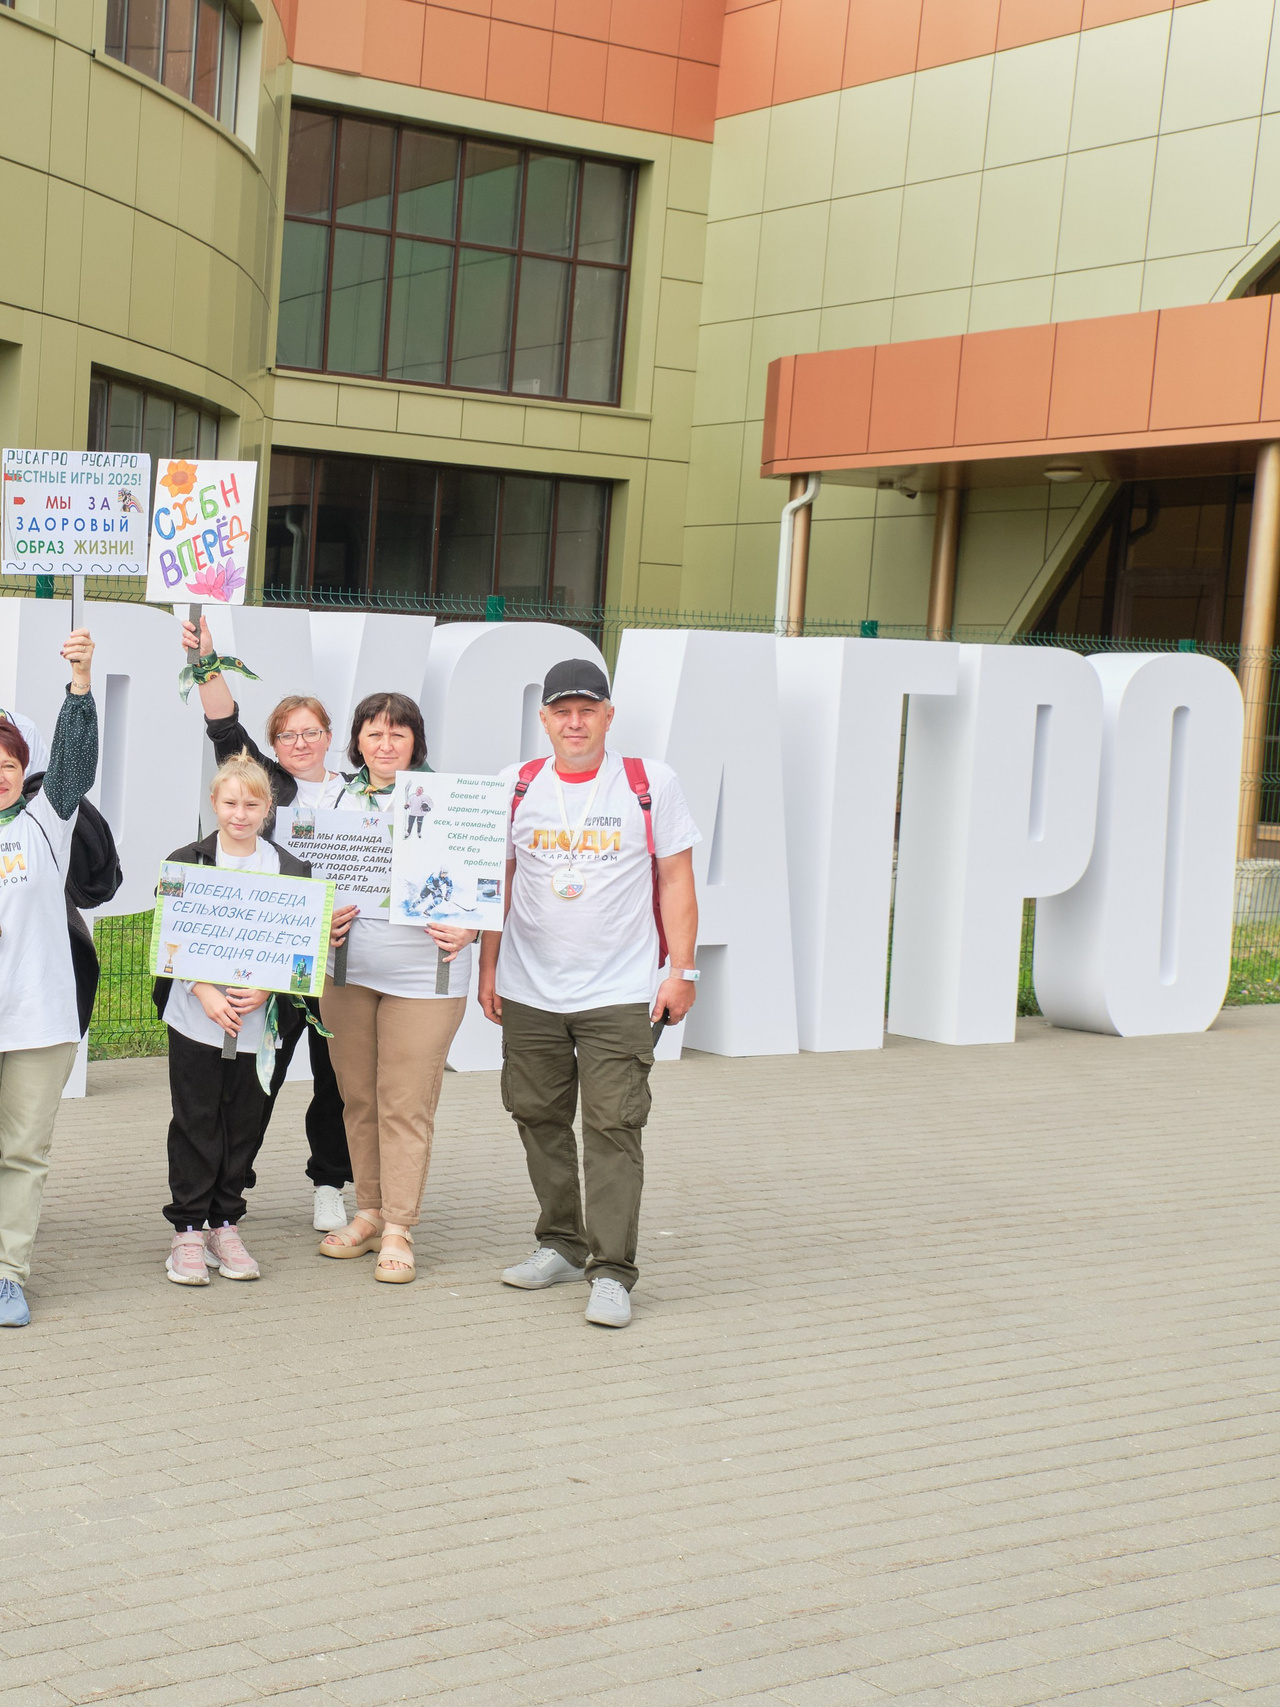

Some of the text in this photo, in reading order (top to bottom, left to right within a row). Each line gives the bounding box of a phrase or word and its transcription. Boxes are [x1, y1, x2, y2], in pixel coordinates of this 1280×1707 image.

[7, 449, 139, 469] РУСАГРО РУСАГРО
[7, 469, 142, 487] ЧЕСТНЫЕ ИГРЫ 2025!
[45, 495, 111, 511] МЫ ЗА
[154, 472, 241, 541] СХБН
[16, 515, 129, 533] ЗДОРОВЫЙ
[16, 540, 134, 556] ОБРАЗ ЖИЗНИ!
[159, 515, 249, 589] ВПЕРЁД
[457, 778, 506, 789] Наши парни
[450, 791, 480, 800] боевые
[447, 806, 507, 817] играют лучше
[433, 820, 453, 828] всех,
[461, 821, 497, 829] команда
[592, 816, 622, 828] РУСАГРО
[316, 833, 383, 844] МЫ КОМАНДА
[447, 832, 506, 844] СХБН победит
[528, 829, 621, 854] ЛЮДИ
[298, 851, 360, 863] АГРОНОМОВ,
[467, 845, 481, 854] без
[463, 858, 503, 869] проблем!
[326, 872, 369, 882] ЗАБРАТЬ
[184, 881, 308, 907] ПОБЕДА, ПОБЕДА
[172, 900, 317, 928] СЕЛЬХОЗКЕ НУЖНА!
[172, 920, 312, 948] ПОБЕДЫ ДОБЬЁТСЯ
[314, 885, 335, 987] СХБН СХБН СХБН
[188, 942, 291, 965] СЕГОДНЯ ОНА!
